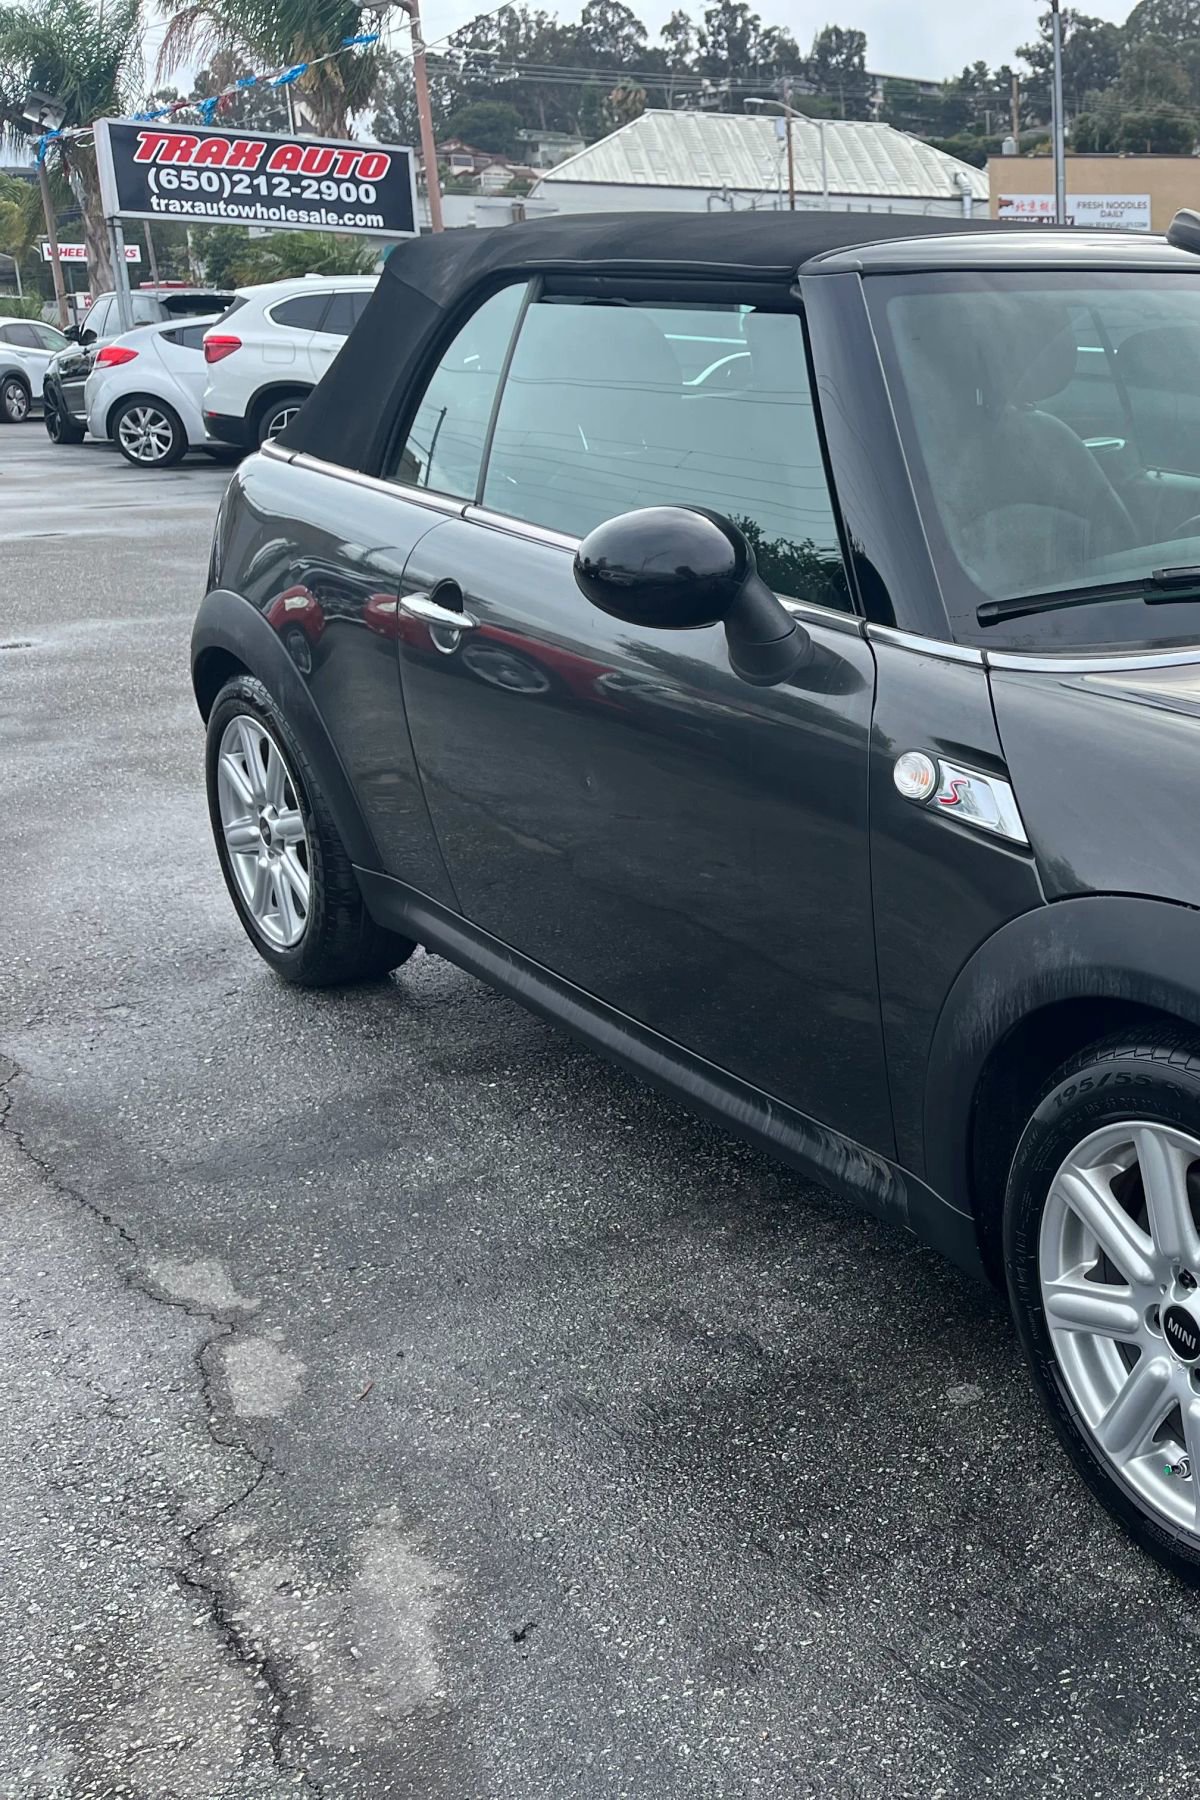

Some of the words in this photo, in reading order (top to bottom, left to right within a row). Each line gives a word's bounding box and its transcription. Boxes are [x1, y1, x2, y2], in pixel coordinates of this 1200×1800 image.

[133, 132, 267, 171] TRAX
[267, 144, 391, 182] AUTO
[147, 167, 377, 205] (650)212-2900
[150, 194, 385, 228] traxautowholesale.com
[1077, 201, 1104, 209] FRESH
[1106, 201, 1148, 209] NOODLES
[1053, 1071, 1153, 1107] 195/55
[1167, 1317, 1197, 1350] MINI
